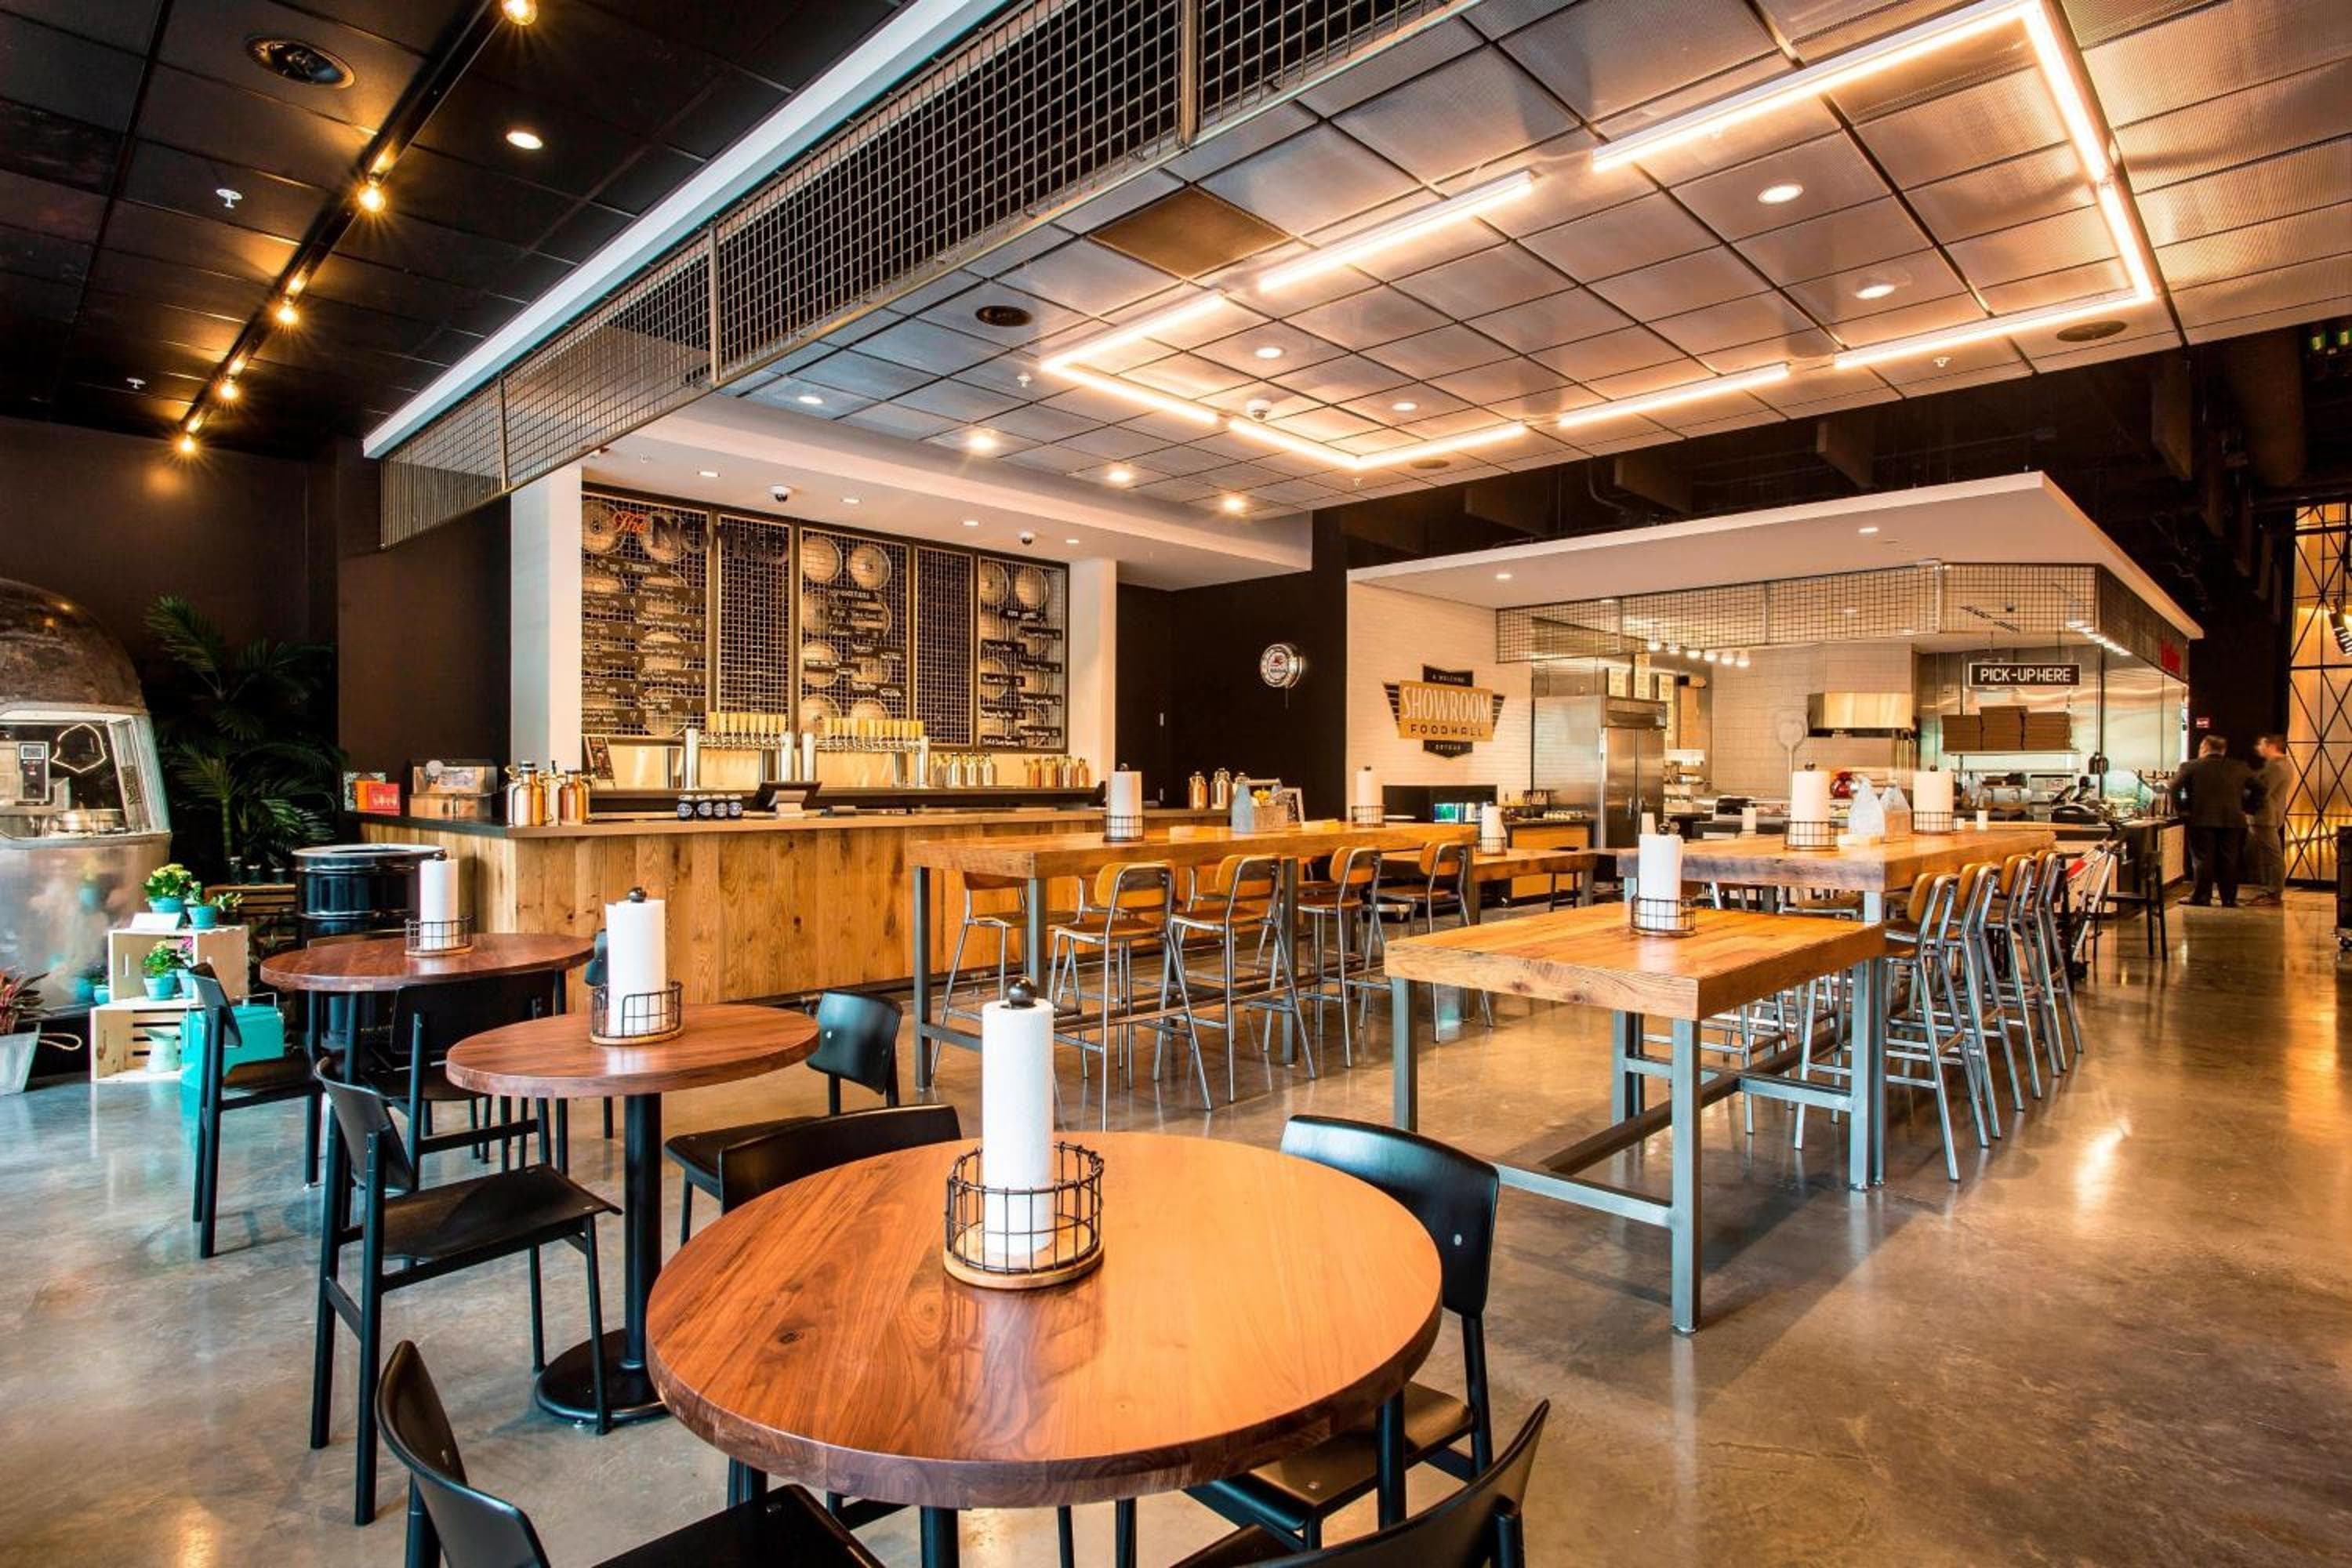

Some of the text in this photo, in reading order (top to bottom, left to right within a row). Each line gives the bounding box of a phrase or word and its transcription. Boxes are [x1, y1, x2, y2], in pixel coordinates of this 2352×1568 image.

[1980, 668, 2071, 682] PICK-UP HERE
[1403, 687, 1490, 723] SHOWROOM
[1410, 724, 1483, 737] FOODHALL
